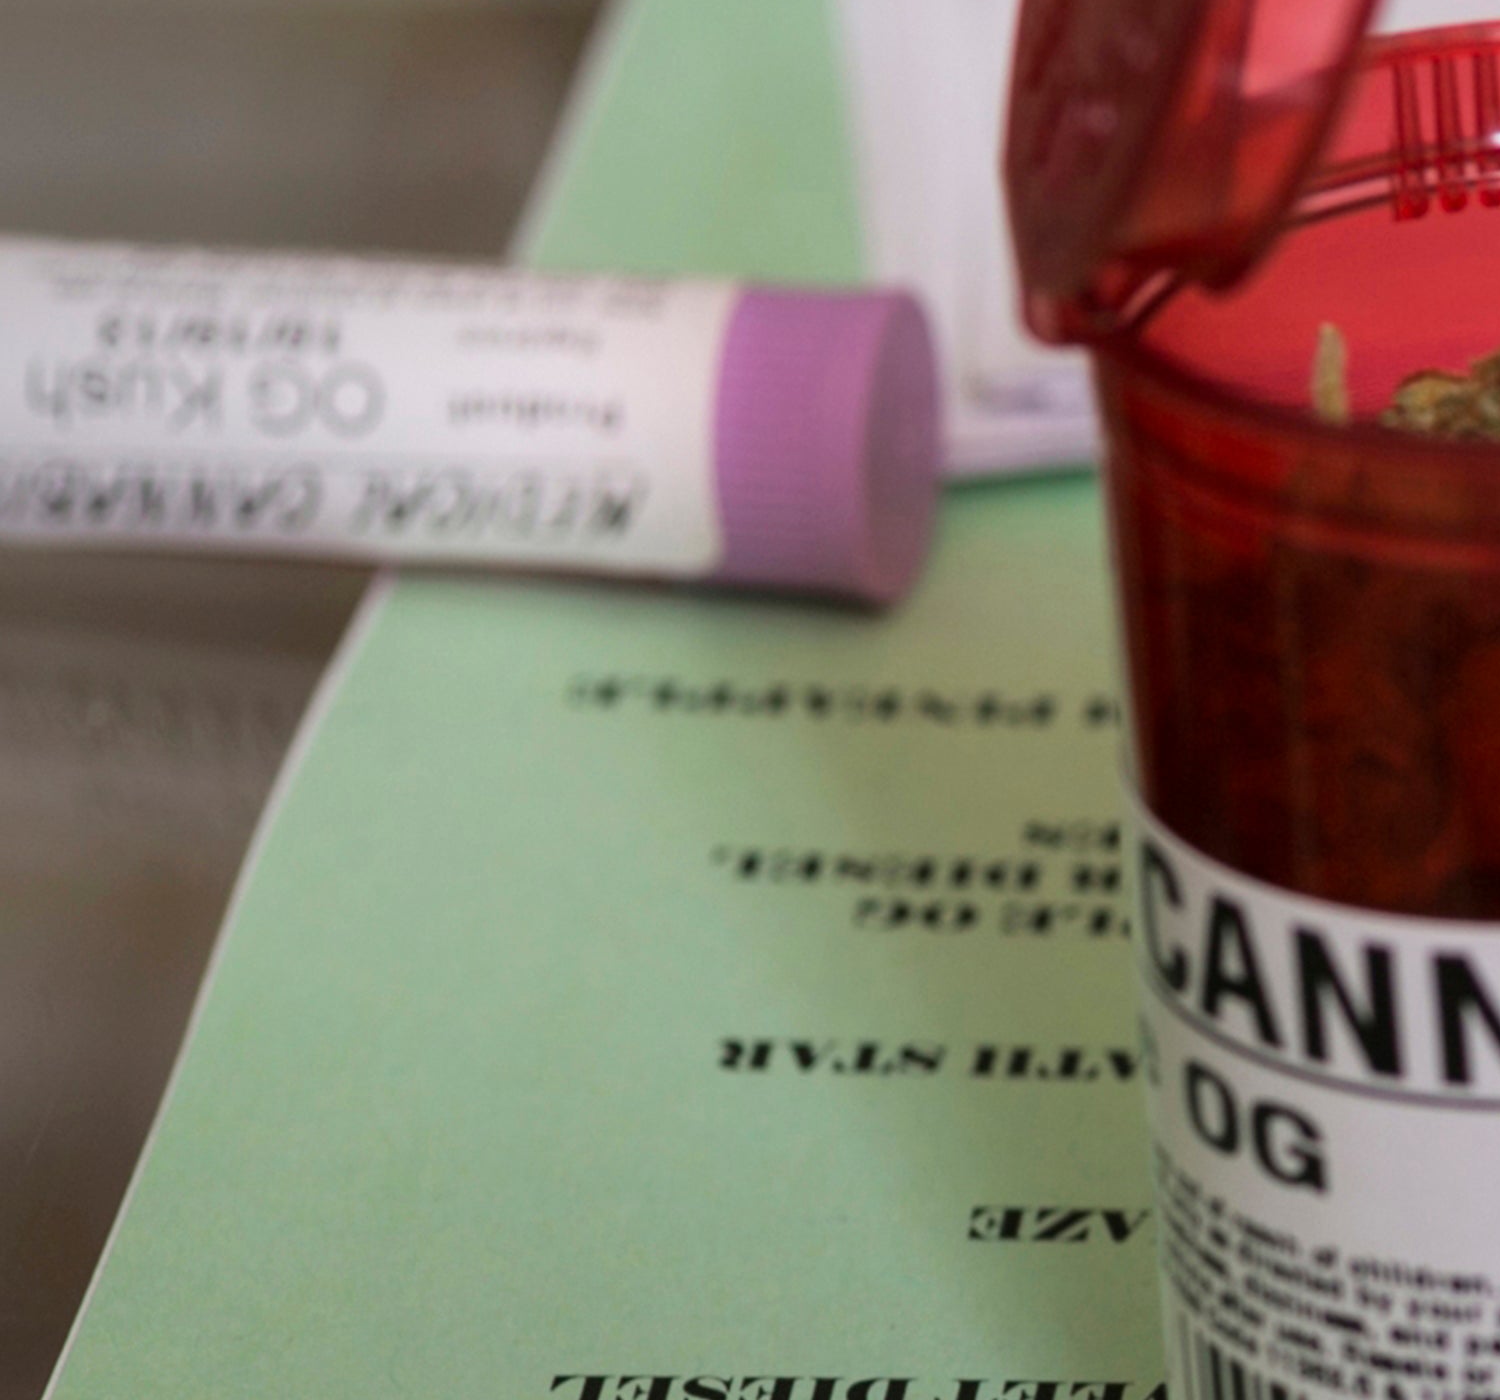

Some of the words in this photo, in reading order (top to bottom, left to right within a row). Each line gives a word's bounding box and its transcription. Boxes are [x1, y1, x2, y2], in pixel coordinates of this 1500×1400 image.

[20, 356, 226, 438] Kush
[246, 360, 388, 443] OG
[0, 462, 327, 540] CANNABI
[716, 1037, 947, 1076] STAR
[968, 1043, 1142, 1081] ATH
[1182, 1060, 1330, 1194] OG
[967, 1206, 1152, 1244] AZE
